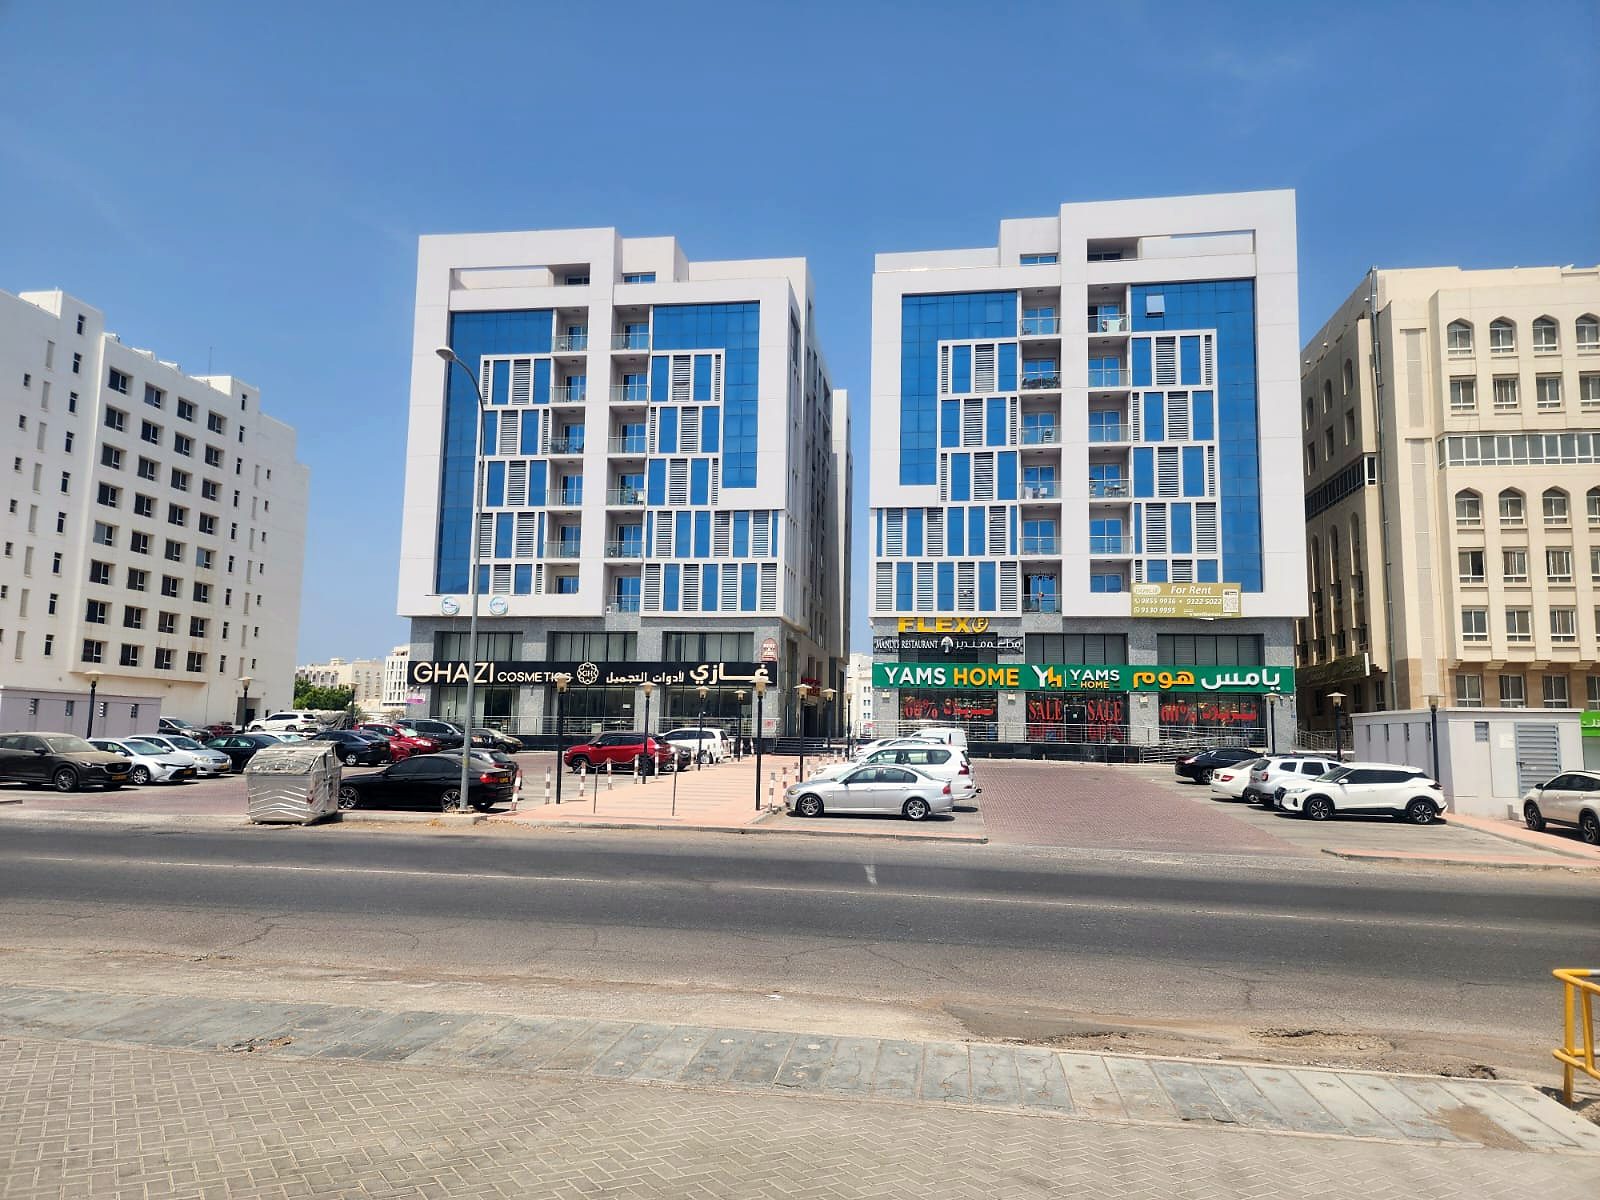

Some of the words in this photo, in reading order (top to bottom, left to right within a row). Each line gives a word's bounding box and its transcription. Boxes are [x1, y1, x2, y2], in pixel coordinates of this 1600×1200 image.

[1170, 585, 1186, 594] For
[1189, 586, 1211, 594] Rent
[898, 617, 970, 632] FLEX
[901, 640, 938, 649] RESTAURANT
[413, 662, 495, 684] GHAZI
[689, 662, 769, 685] غازي
[884, 667, 946, 685] YAMS
[953, 668, 1019, 686] HOME
[1069, 669, 1120, 681] YAMS
[1133, 671, 1195, 689] هوم
[1201, 668, 1281, 691] يامس
[1028, 700, 1063, 720] SALE
[1087, 700, 1123, 720] SALE
